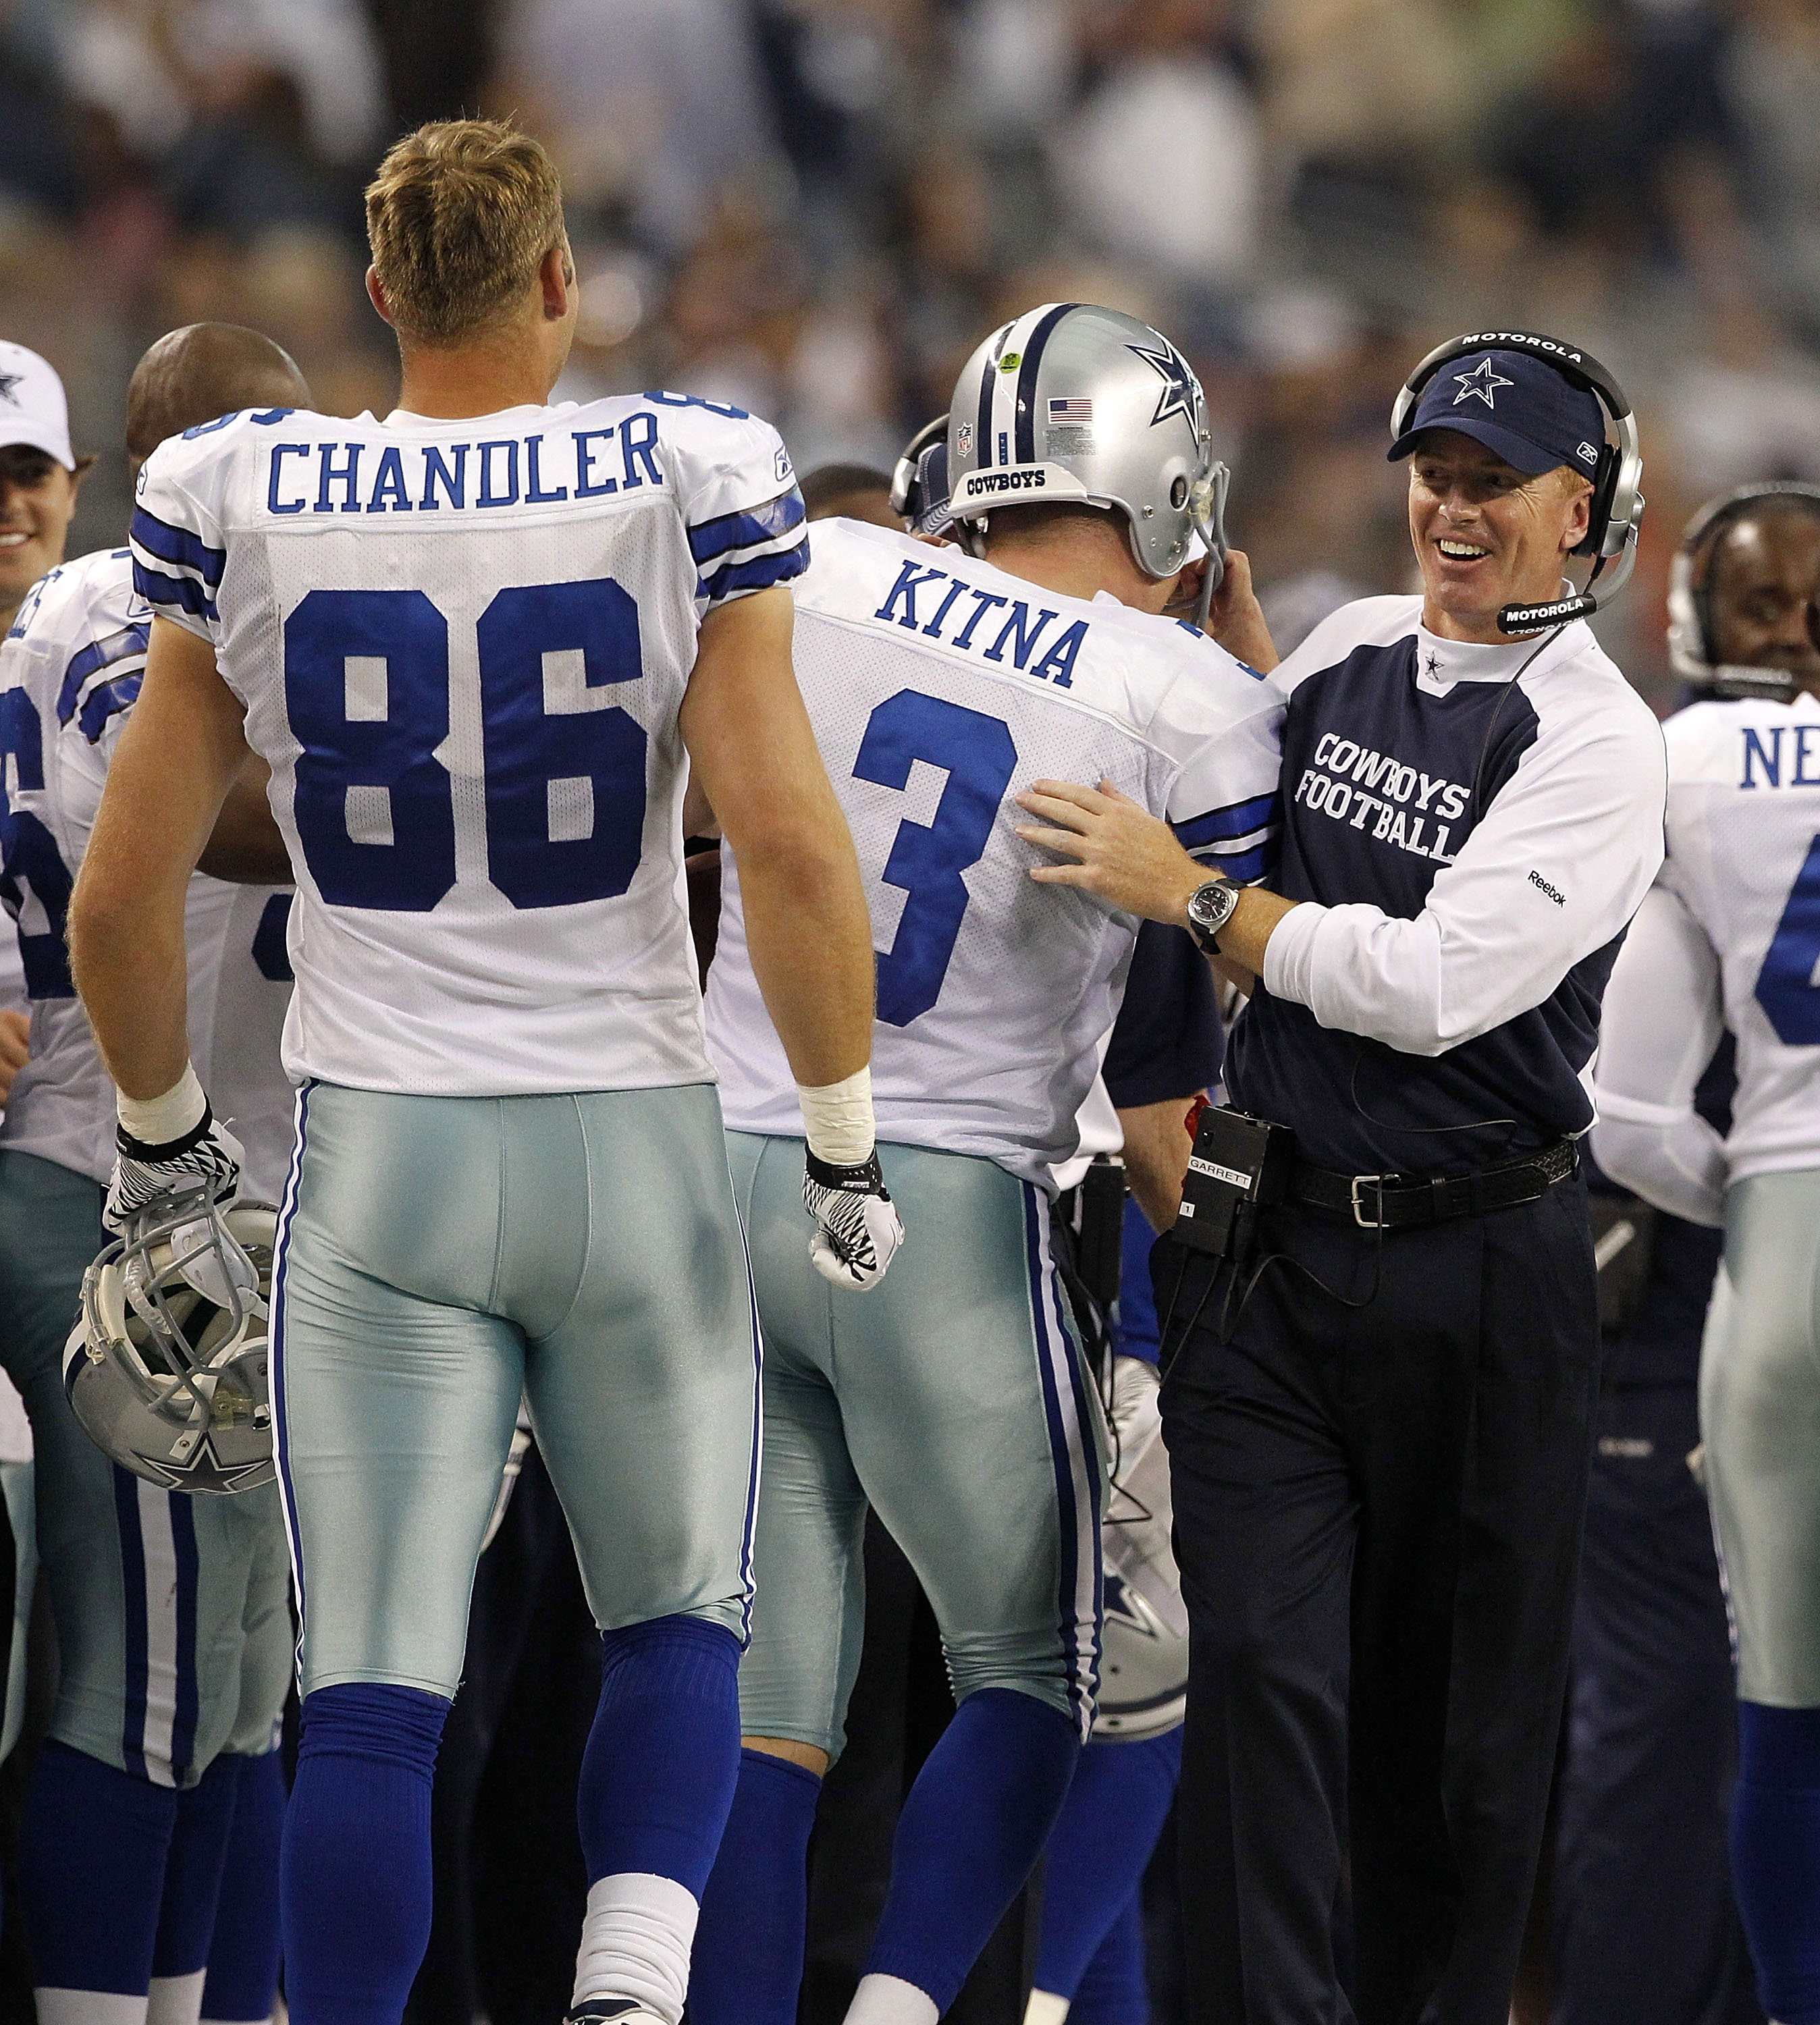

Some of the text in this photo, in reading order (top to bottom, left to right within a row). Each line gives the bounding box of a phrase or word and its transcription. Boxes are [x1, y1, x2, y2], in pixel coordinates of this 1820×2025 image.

[1462, 333, 1582, 364] MOTOROLA
[268, 412, 663, 514] CHANDLER
[967, 469, 1045, 496] COWBOYS
[874, 559, 1090, 688] KITNA
[1506, 598, 1584, 622] MOTOROLA
[284, 577, 647, 912] 86
[1314, 731, 1471, 821] COWBOYS
[1740, 726, 1820, 788] NE
[1295, 770, 1456, 865] FOOTBALL
[852, 688, 1018, 1027] 3
[1528, 869, 1566, 908] Reebok
[1190, 1159, 1249, 1185] GARRETT
